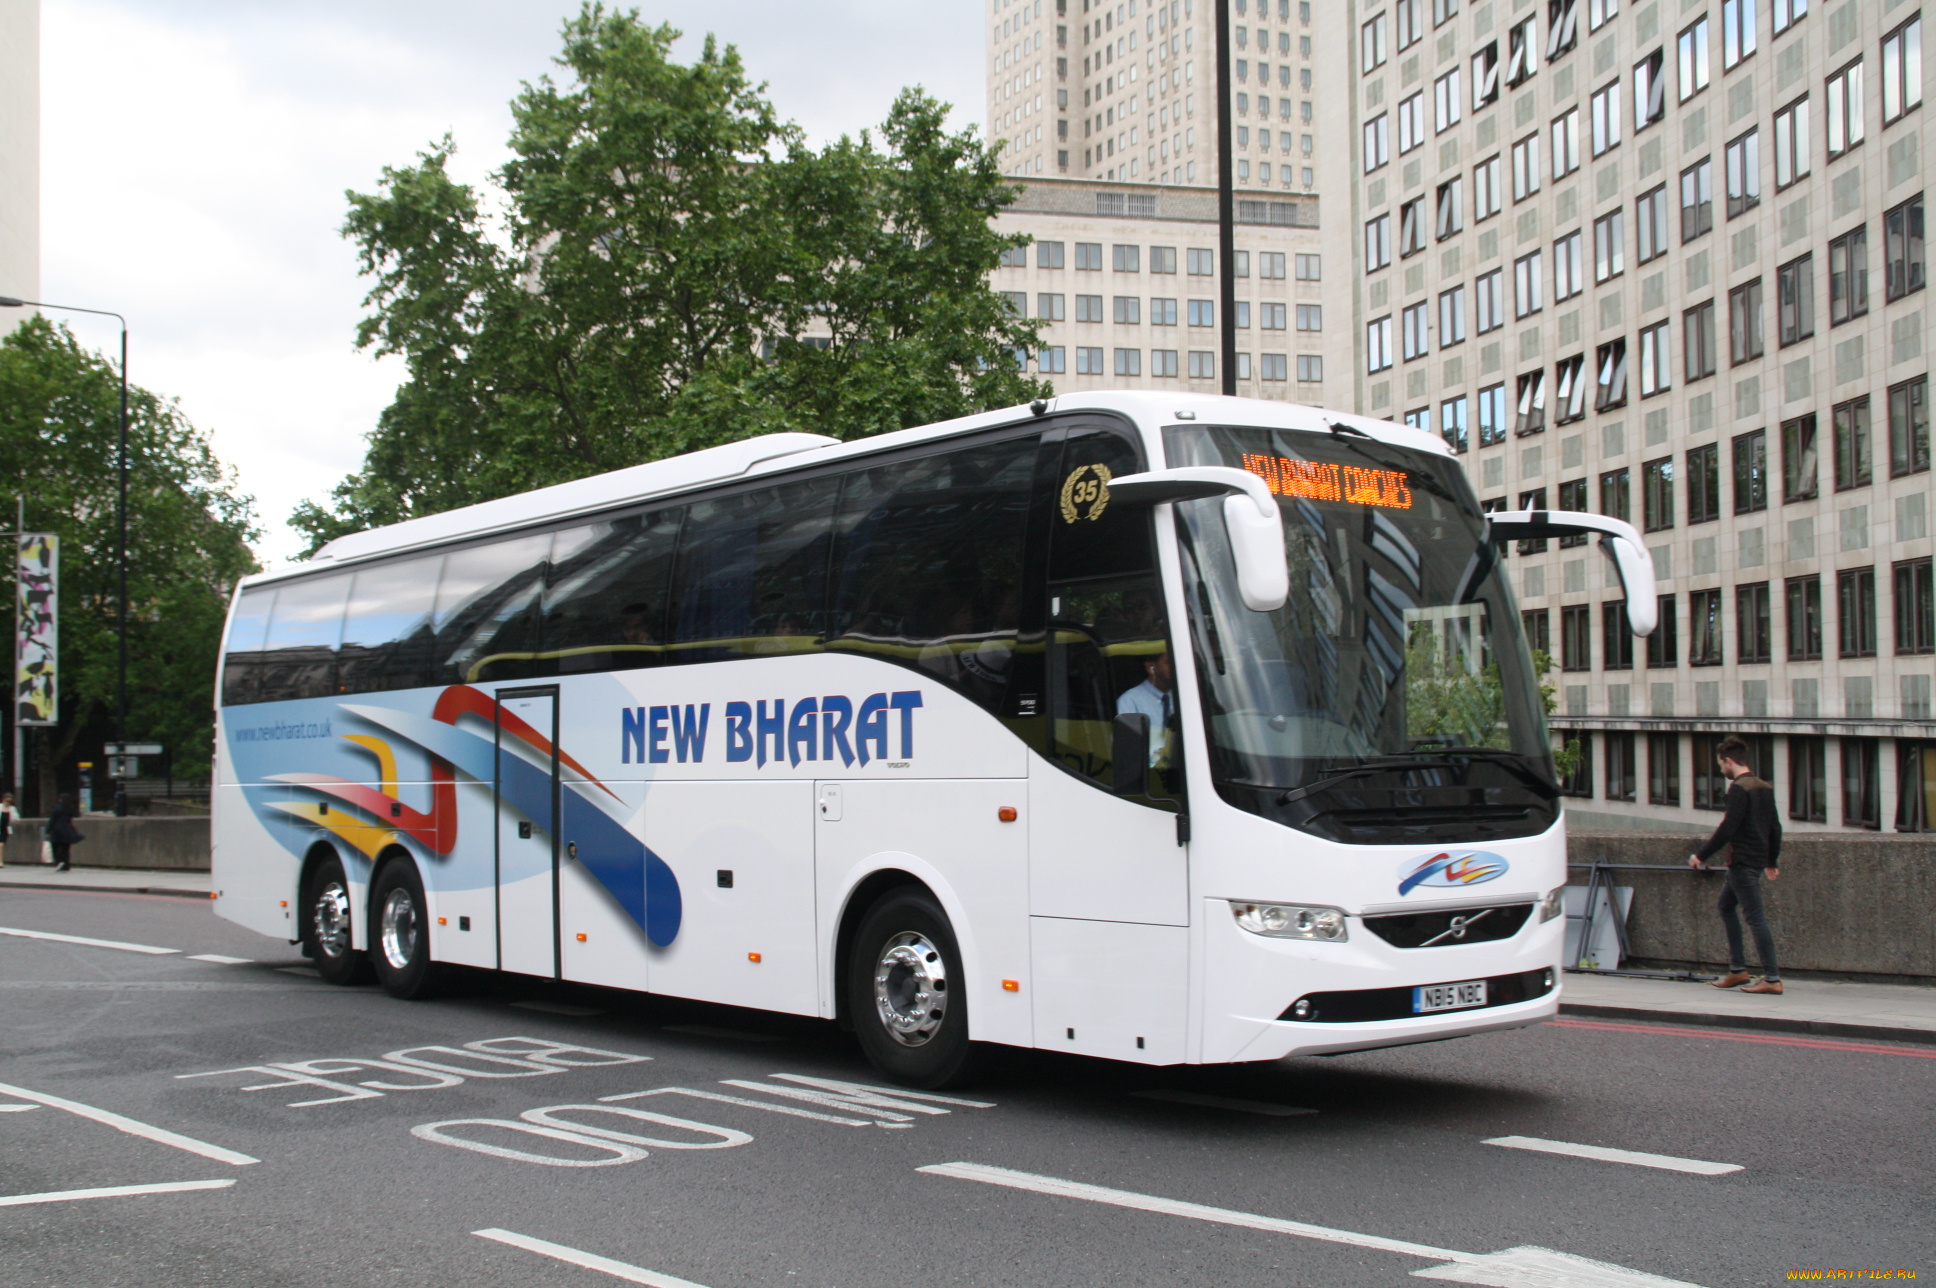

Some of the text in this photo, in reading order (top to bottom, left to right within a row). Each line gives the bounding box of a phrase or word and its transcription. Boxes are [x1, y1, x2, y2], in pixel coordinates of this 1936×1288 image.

[1074, 479, 1099, 503] 35
[1279, 457, 1342, 501] BHARAT
[1343, 466, 1412, 509] COACHES
[235, 717, 332, 742] www.newbharat.co.uk
[621, 690, 924, 770] NEW BHARAT
[1424, 983, 1483, 1008] NB15 NBC
